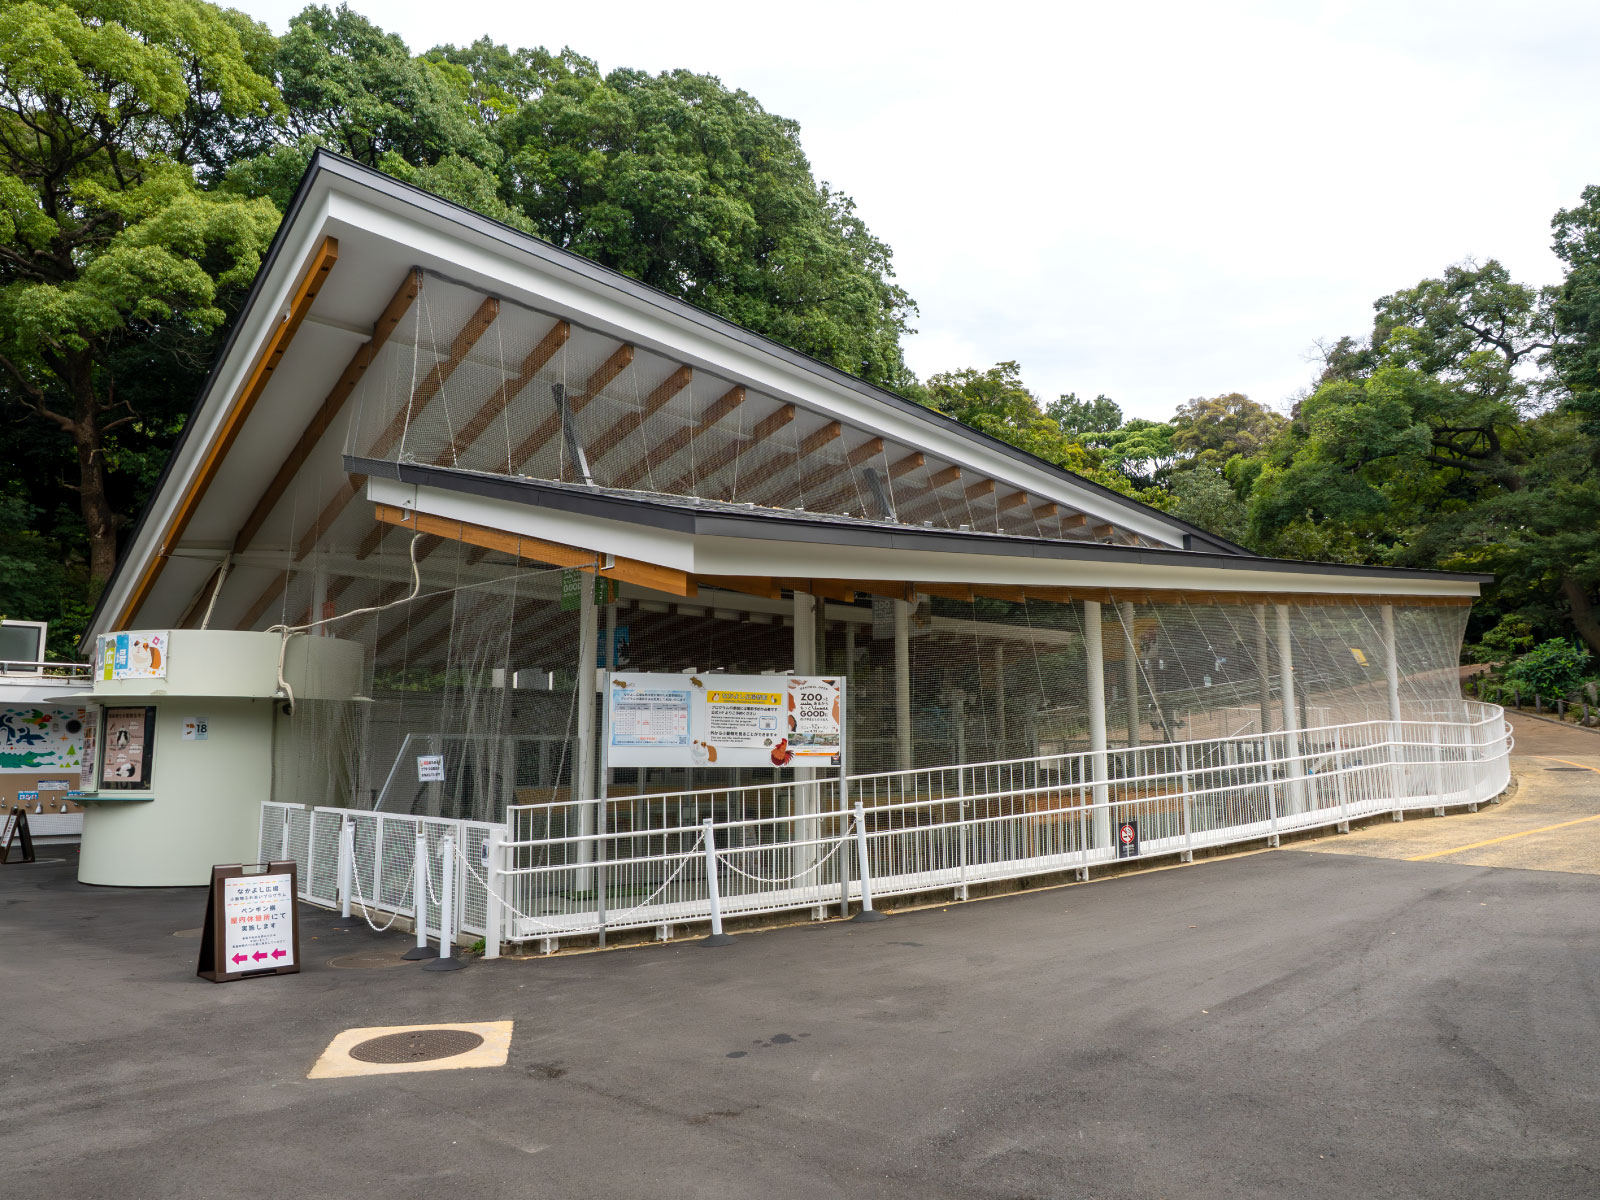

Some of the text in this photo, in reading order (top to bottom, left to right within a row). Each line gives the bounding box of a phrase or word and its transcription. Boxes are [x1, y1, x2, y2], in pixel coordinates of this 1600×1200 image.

[196, 724, 208, 733] 18
[237, 885, 278, 894] なかよし広場
[241, 922, 276, 932] 実施します
